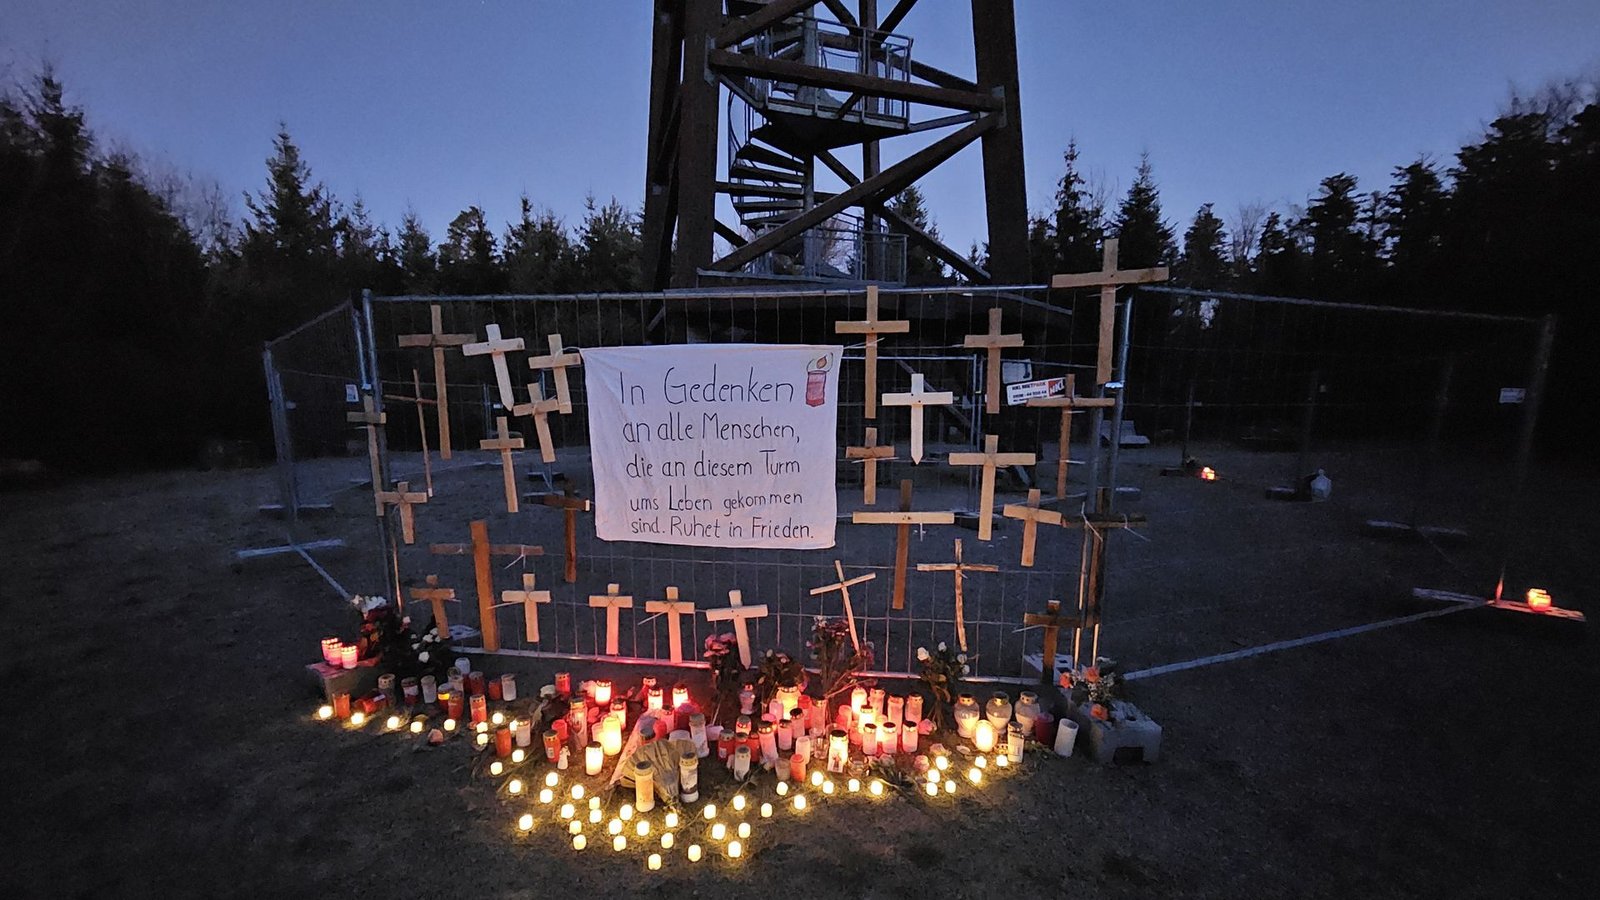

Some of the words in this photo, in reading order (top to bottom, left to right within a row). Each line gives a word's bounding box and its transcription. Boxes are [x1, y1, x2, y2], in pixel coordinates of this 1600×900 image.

[619, 371, 645, 405] In
[664, 363, 795, 405] Gedenken
[622, 421, 651, 443] an
[657, 411, 694, 442] alle
[702, 412, 801, 444] Menschen,
[625, 453, 654, 478] die
[661, 460, 686, 477] an
[693, 450, 752, 478] diesem
[759, 449, 801, 476] Turm
[629, 497, 660, 512] ums
[668, 485, 713, 512] Leben
[723, 490, 803, 517] gekommen
[631, 516, 666, 535] sind.
[670, 515, 721, 539] Ruhet
[729, 521, 743, 539] in
[751, 516, 815, 539] Frieden.
